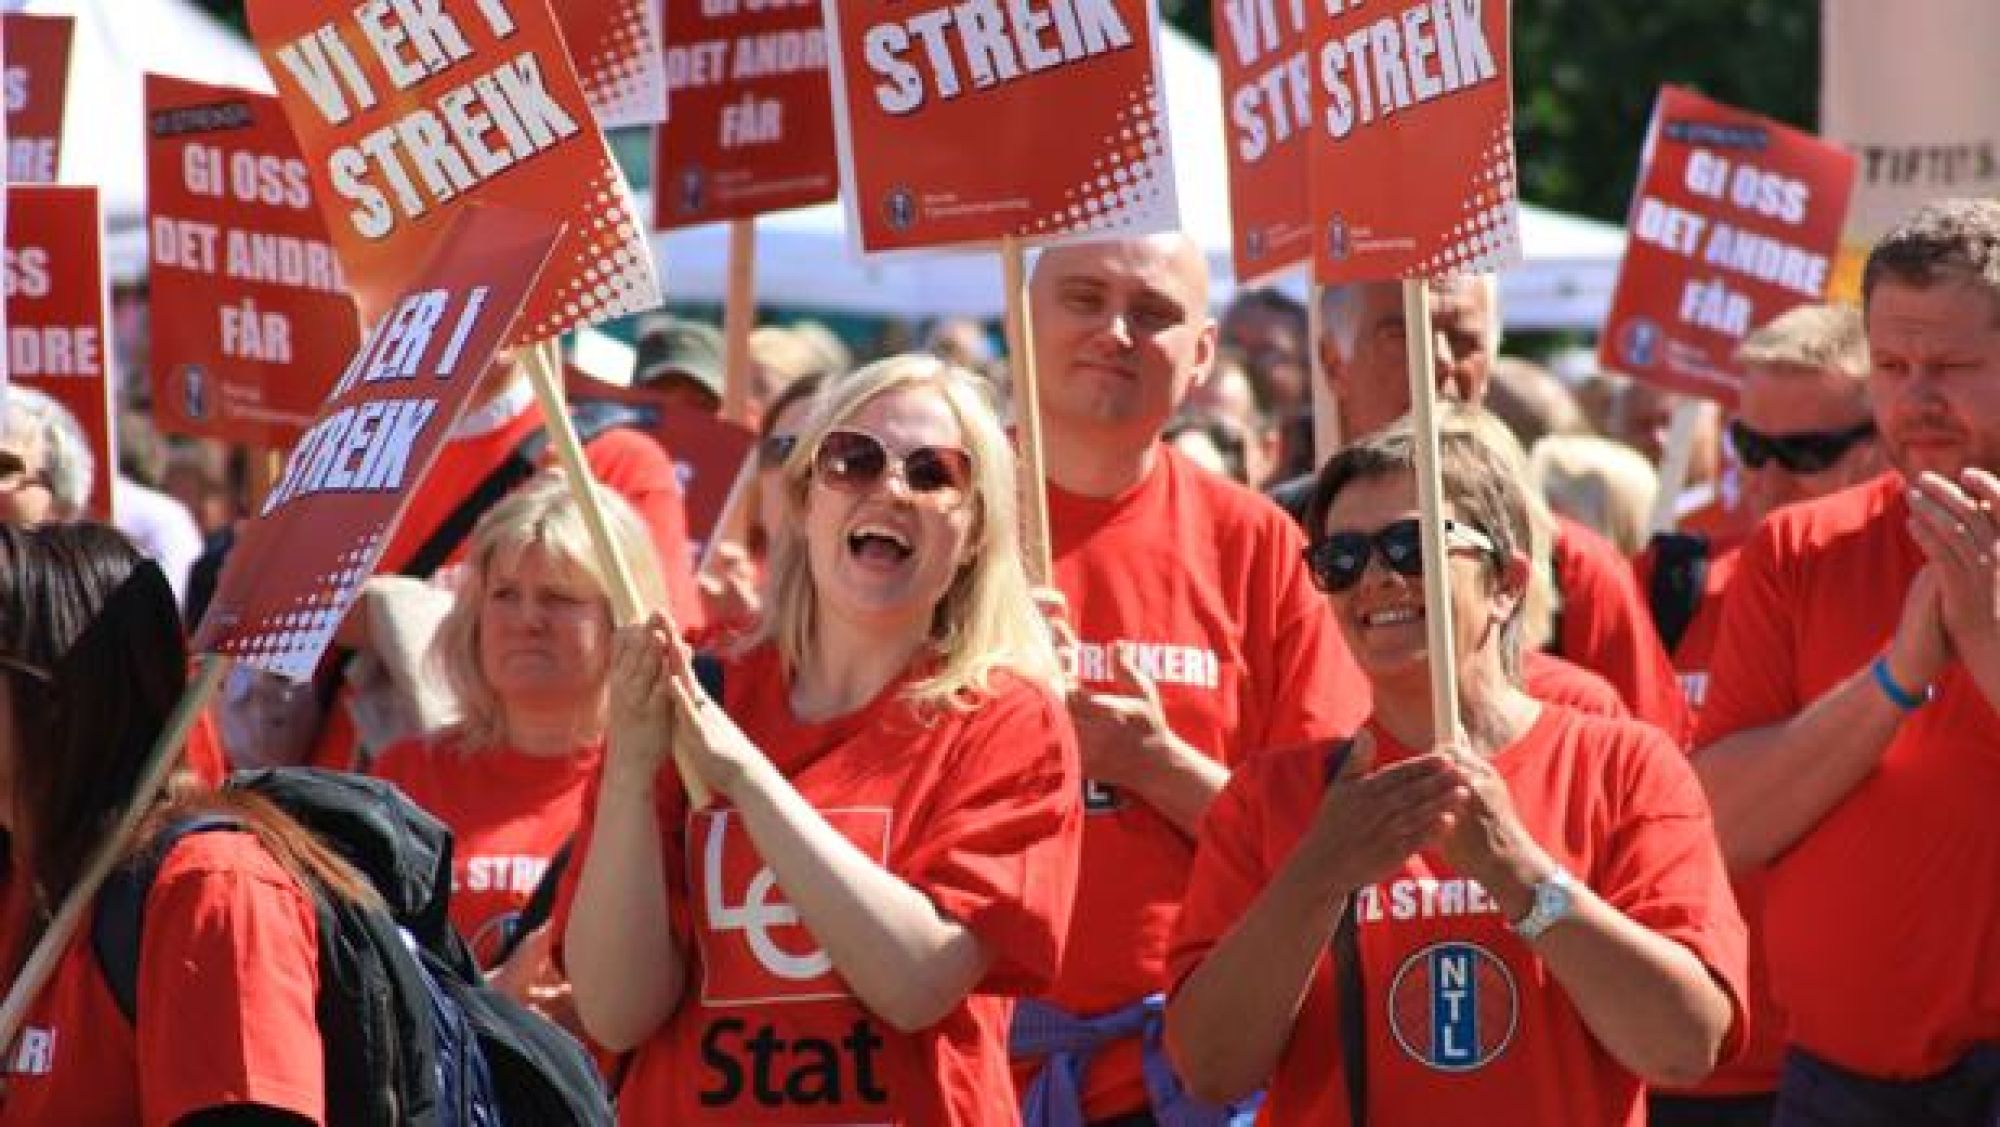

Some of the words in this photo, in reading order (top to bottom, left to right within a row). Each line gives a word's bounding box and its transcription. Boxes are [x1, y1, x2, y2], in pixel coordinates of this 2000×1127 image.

[277, 23, 378, 126] VI
[354, 0, 476, 89] ER
[864, 0, 1134, 115] STREIK
[1320, 0, 1498, 138] STREIK
[328, 51, 581, 239] STREIK
[720, 91, 783, 149] FÅR
[184, 143, 225, 197] GI
[230, 151, 311, 210] OSS
[1685, 148, 1731, 198] GI
[1730, 163, 1810, 225] OSS
[152, 214, 219, 274] DET
[1636, 197, 1707, 259] DET
[1705, 223, 1830, 298] ANDRE
[220, 297, 292, 365] FÅR
[363, 288, 449, 381] ER
[434, 285, 490, 377] I
[1680, 277, 1754, 338] FÅR
[1391, 879, 1500, 920] STRE
[1440, 957, 1469, 1060] NTL
[699, 1018, 888, 1107] Stat
